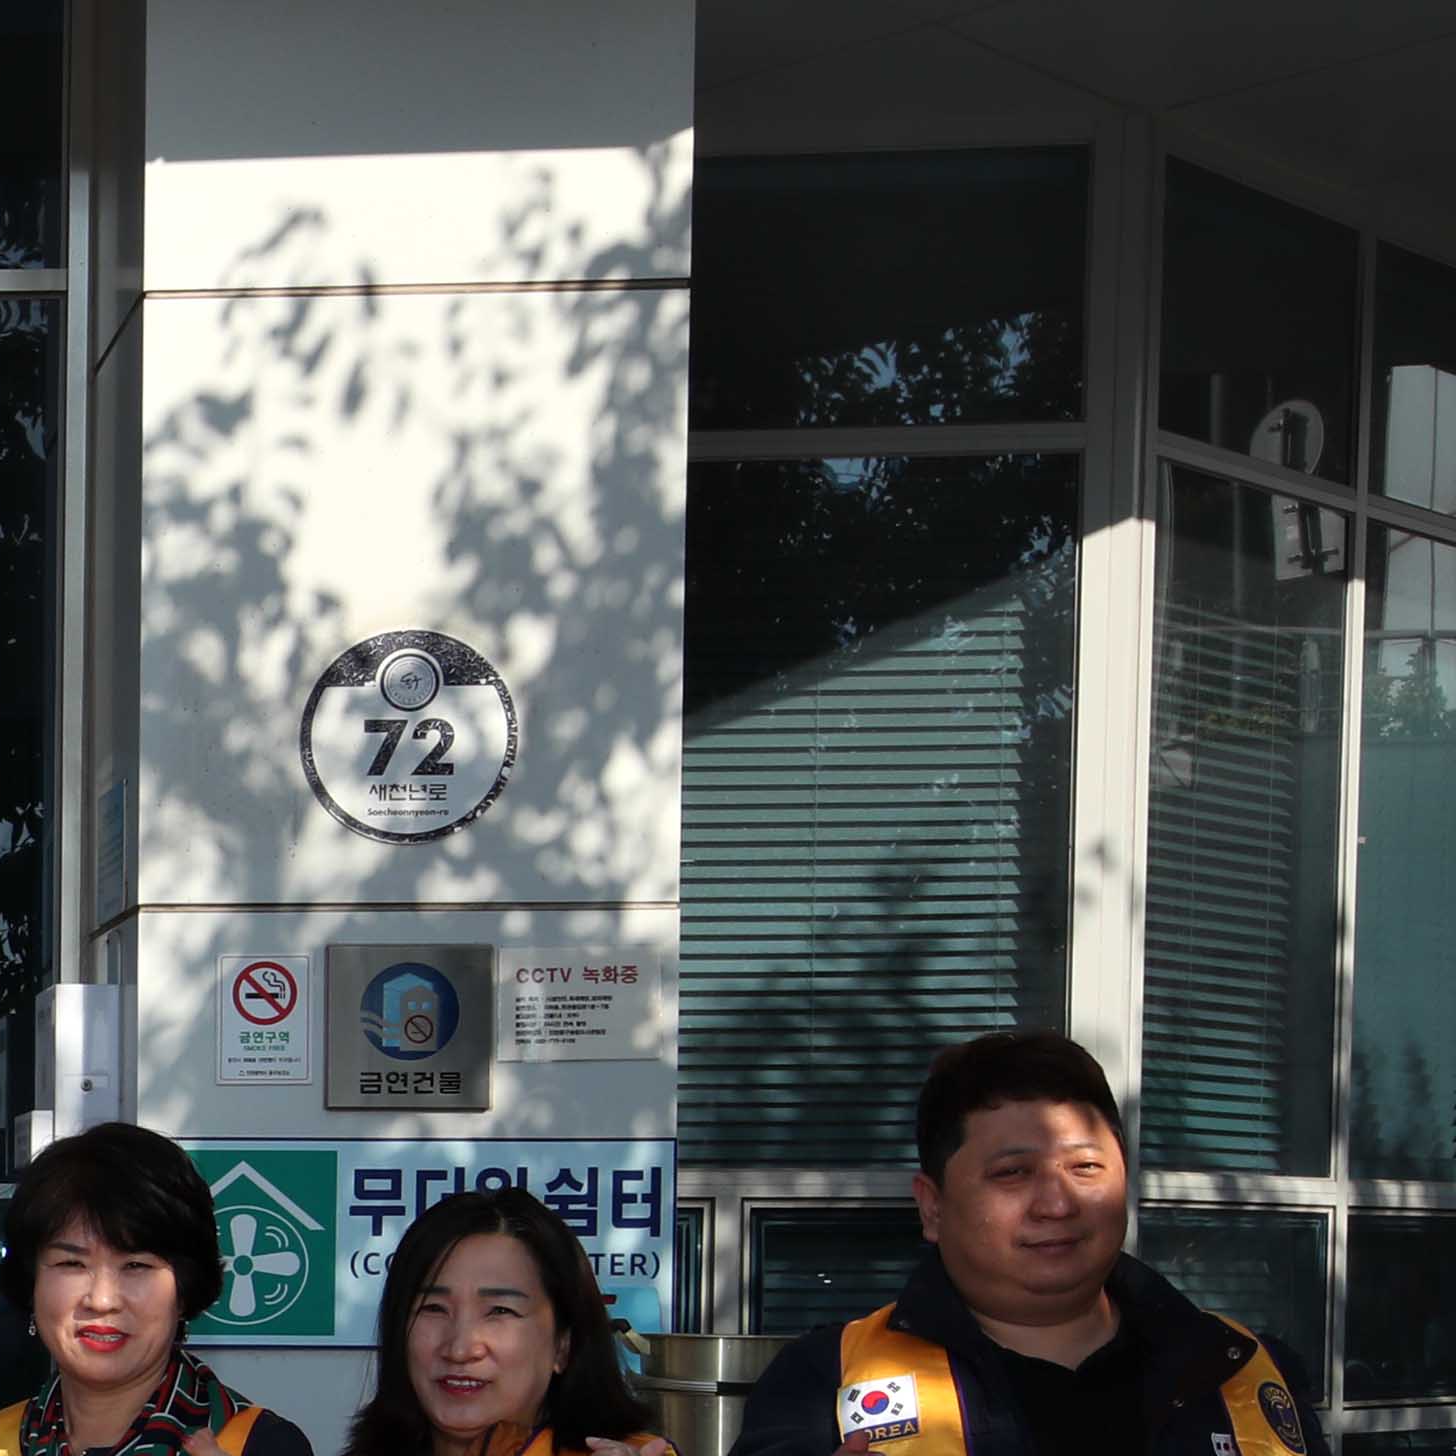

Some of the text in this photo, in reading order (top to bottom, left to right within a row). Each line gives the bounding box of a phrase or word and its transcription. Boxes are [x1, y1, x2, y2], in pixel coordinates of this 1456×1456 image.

[364, 718, 455, 776] 72
[369, 783, 448, 801] 새천년로
[516, 965, 639, 984] CCTV 녹화중
[239, 1031, 289, 1044] 금연구역
[359, 1071, 462, 1095] 금연건물
